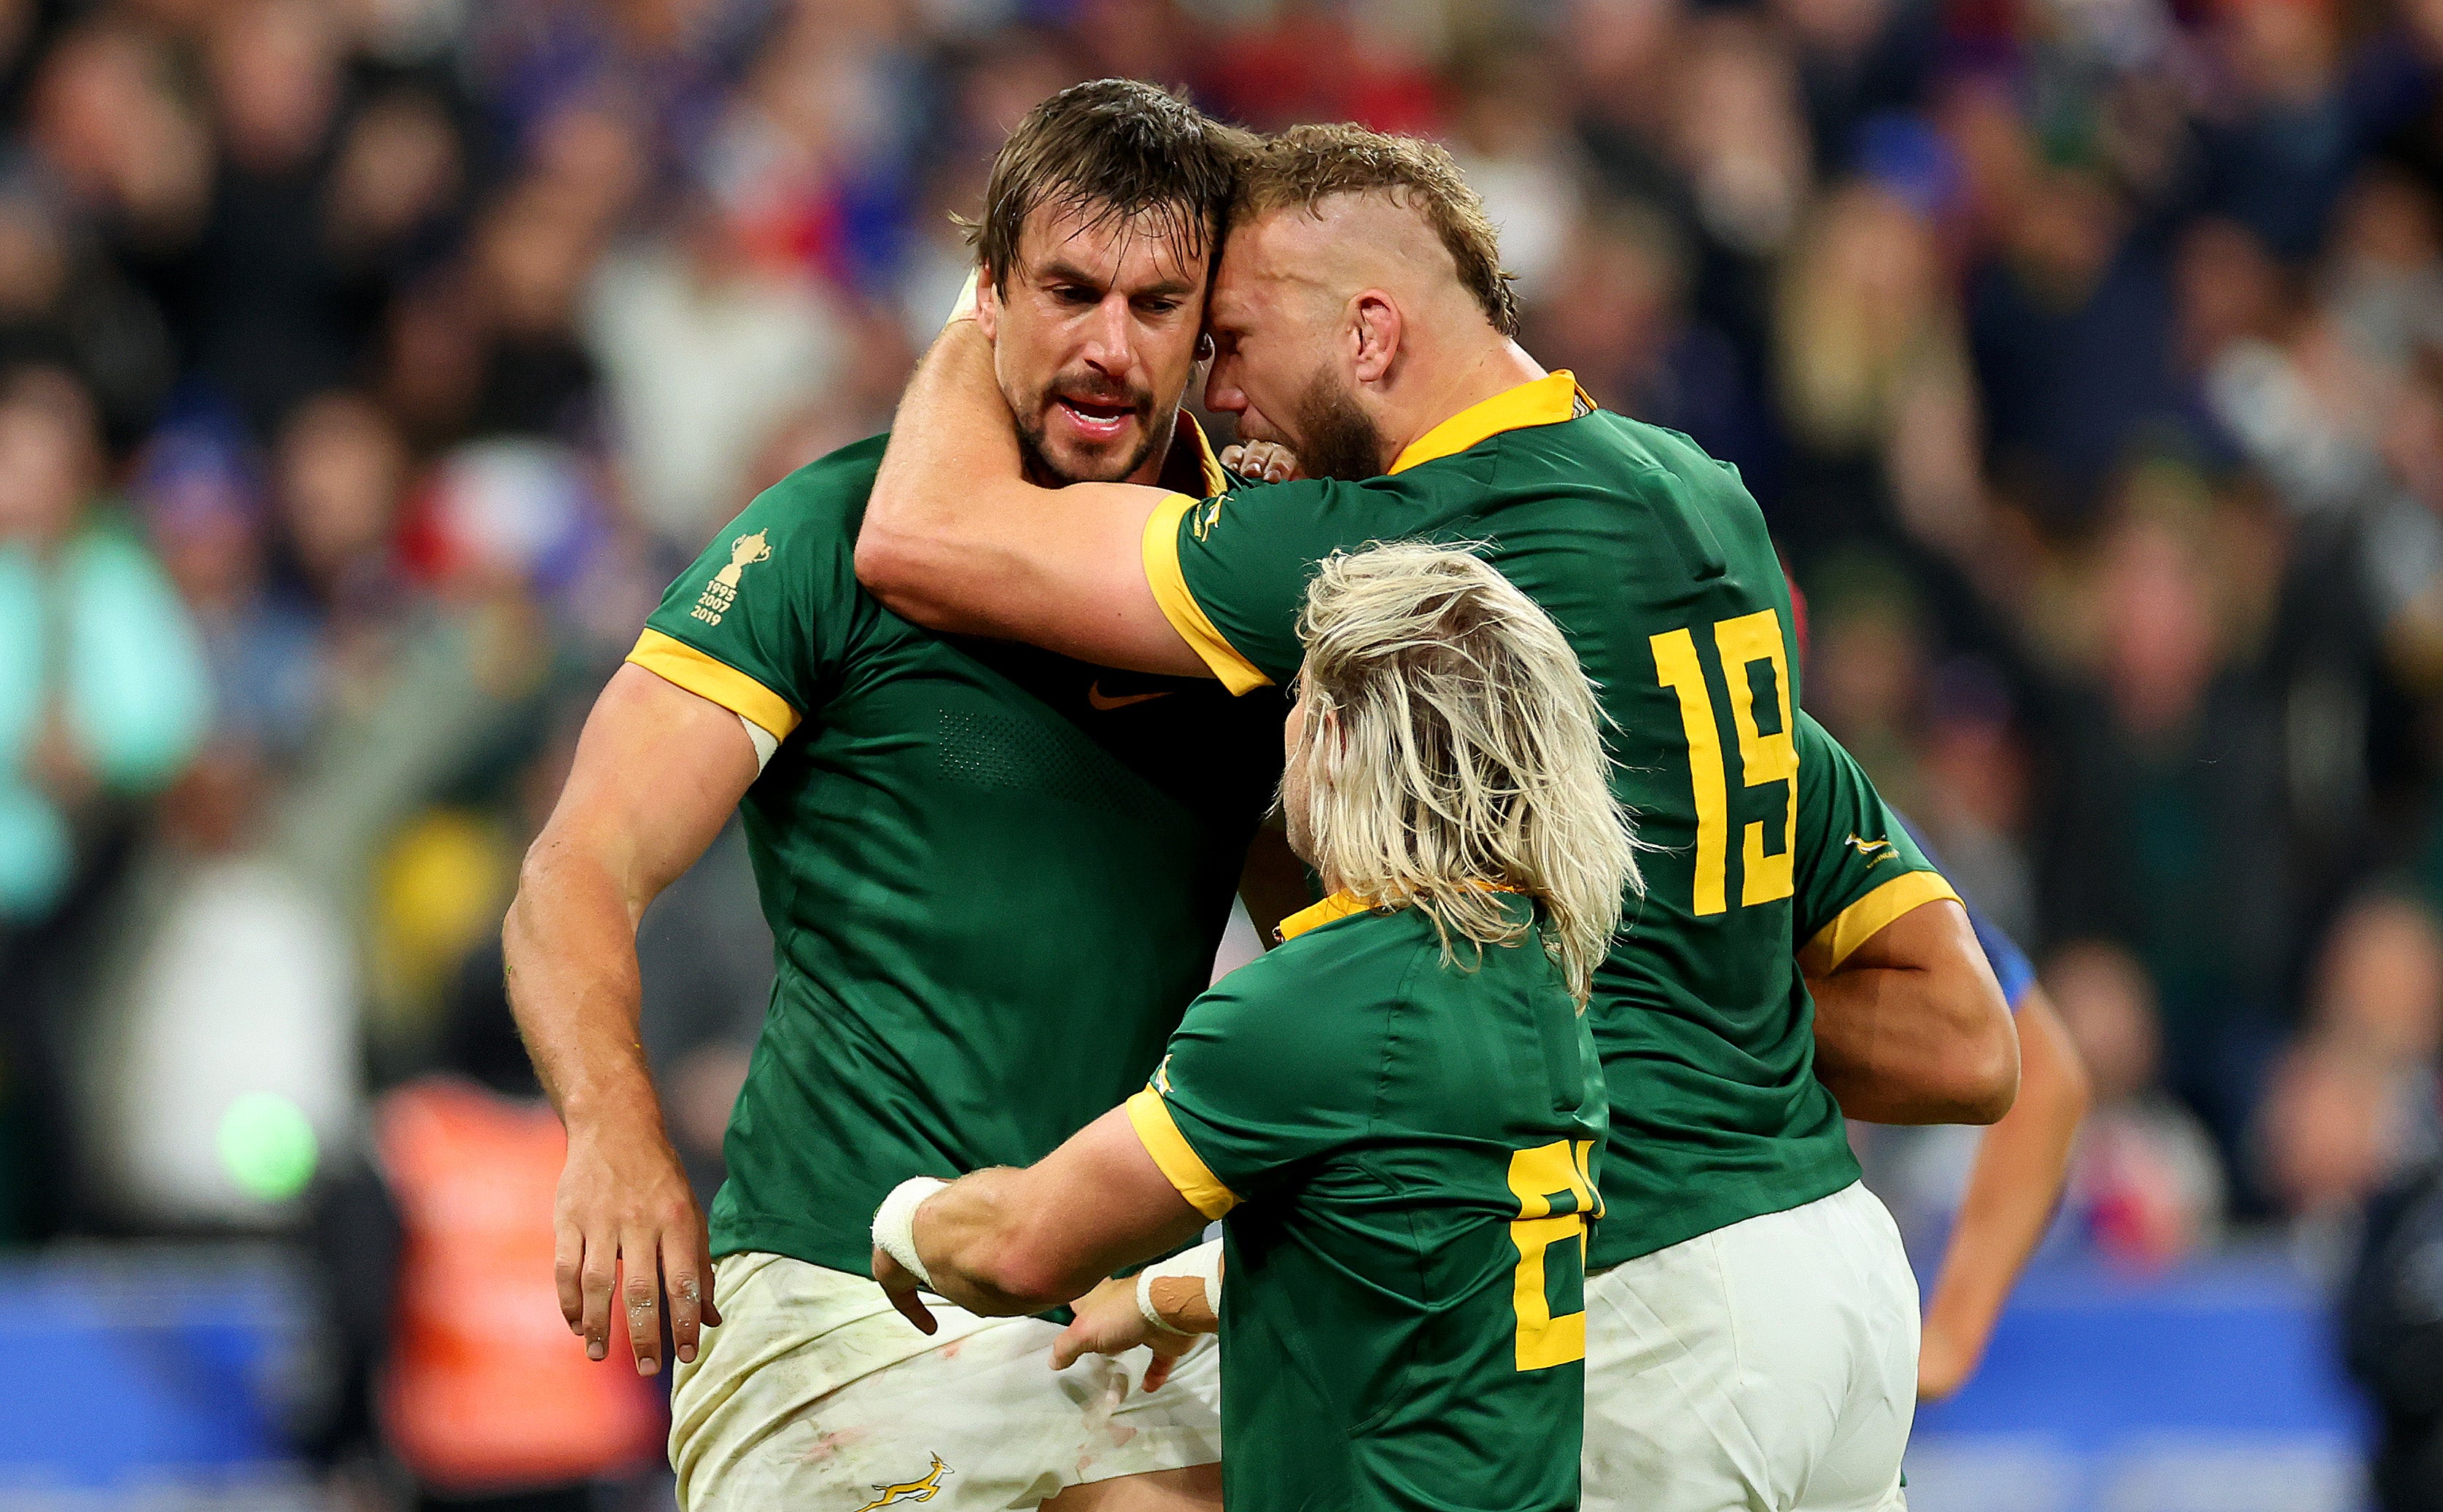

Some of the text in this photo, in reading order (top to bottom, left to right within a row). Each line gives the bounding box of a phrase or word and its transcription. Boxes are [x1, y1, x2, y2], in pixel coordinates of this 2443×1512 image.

[706, 580, 737, 601] 1995
[698, 592, 731, 613] 2007
[691, 604, 722, 626] 2019
[1649, 608, 1799, 916] 19
